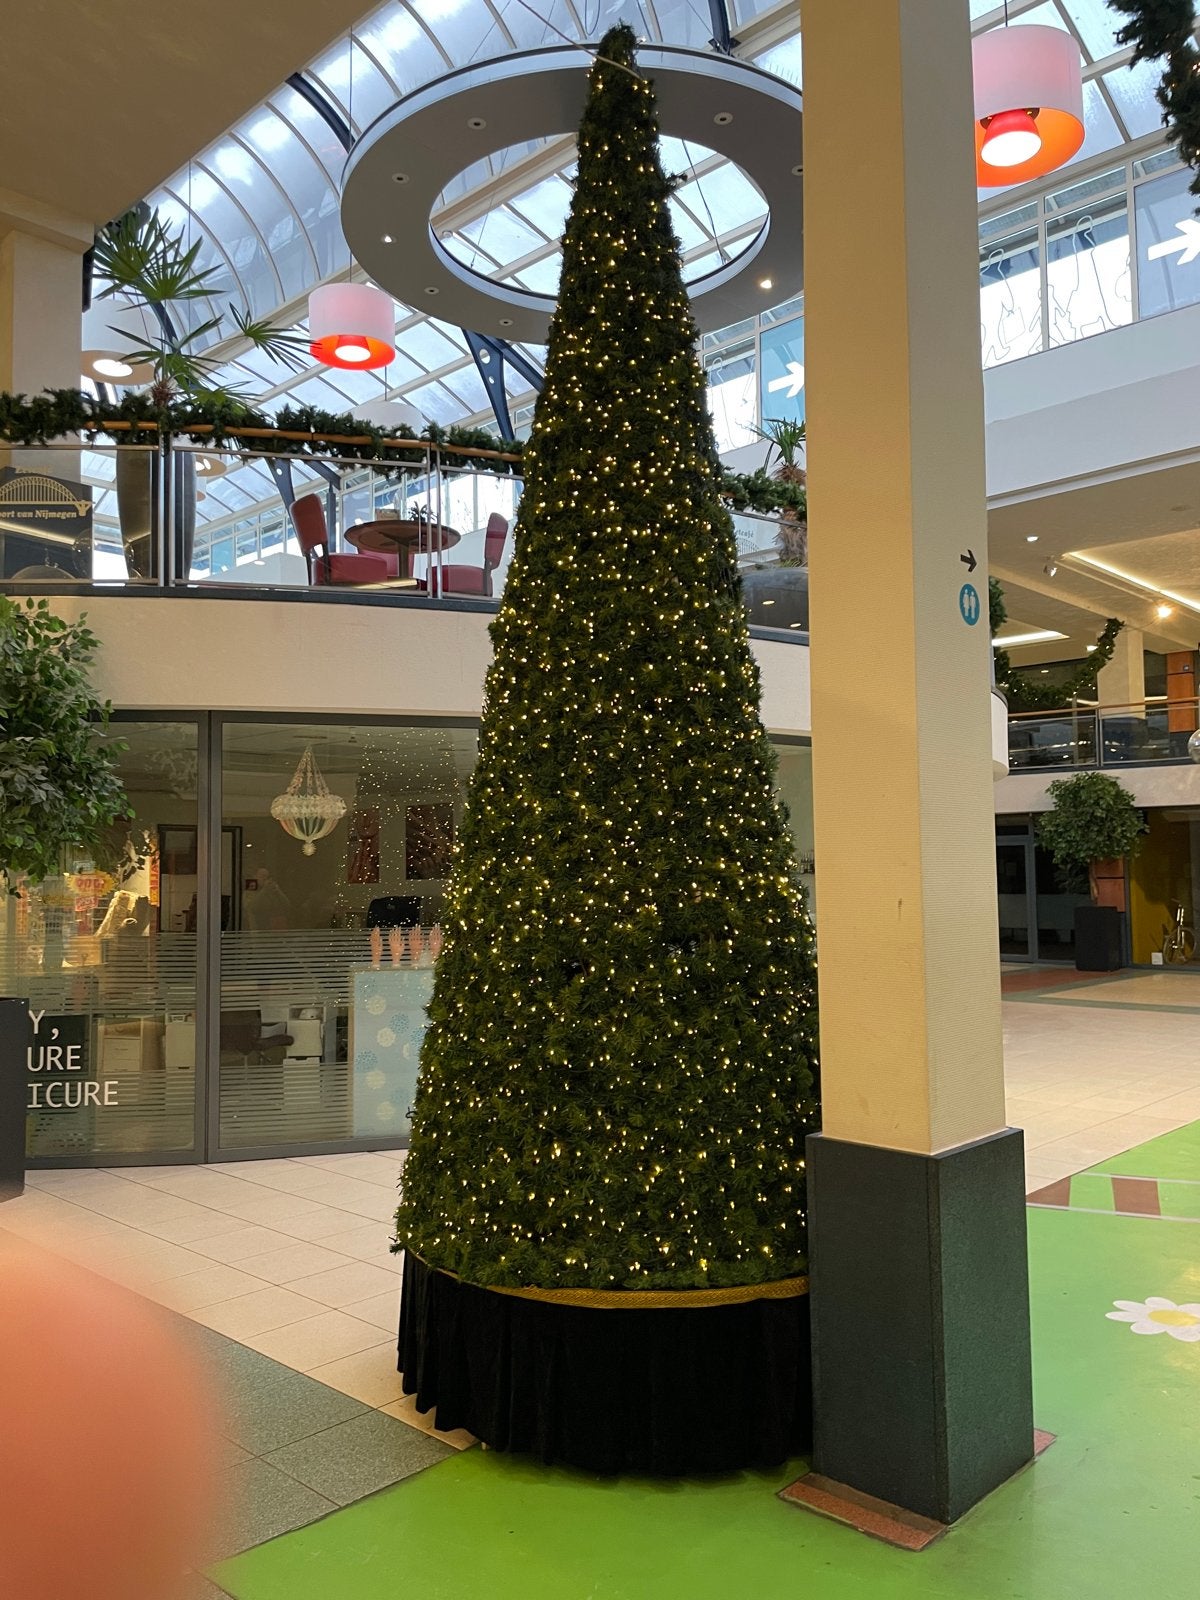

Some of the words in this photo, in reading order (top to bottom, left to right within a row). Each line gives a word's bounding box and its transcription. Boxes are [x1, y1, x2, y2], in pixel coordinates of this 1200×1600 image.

[35, 509, 77, 519] Nijmegen
[28, 1010, 60, 1040] Y,
[27, 1045, 82, 1072] URE
[27, 1081, 119, 1109] ICURE
